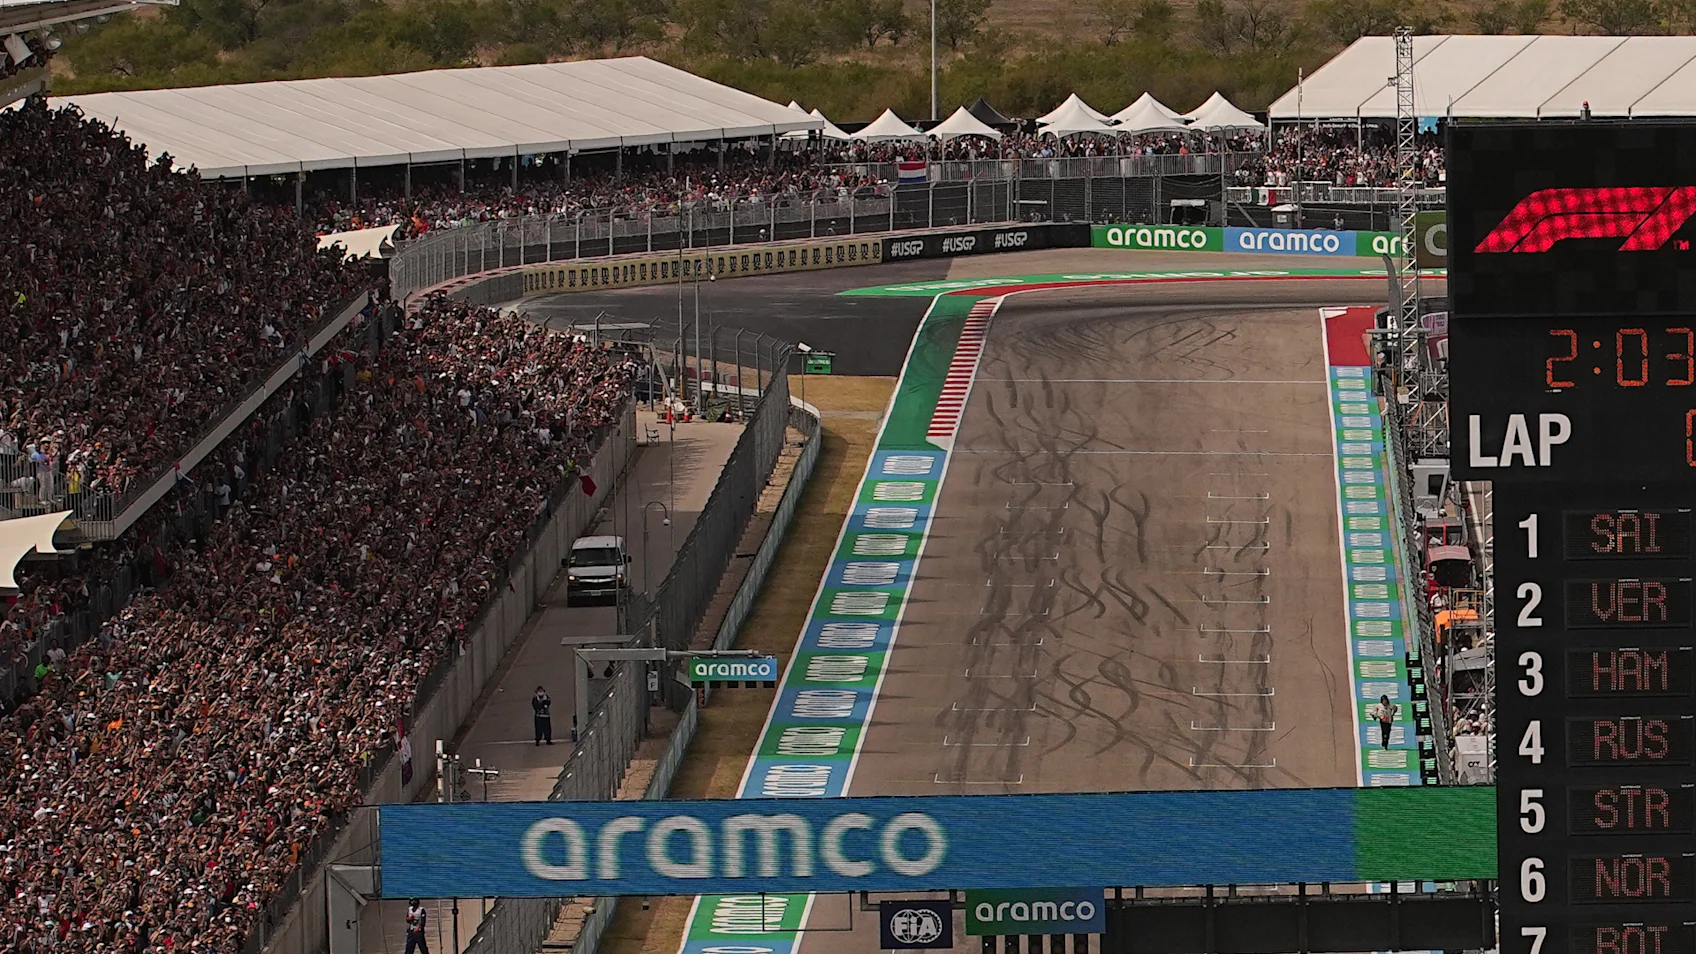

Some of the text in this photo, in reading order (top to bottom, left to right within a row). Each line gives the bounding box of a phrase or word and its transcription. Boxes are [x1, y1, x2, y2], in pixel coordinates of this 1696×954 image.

[891, 240, 924, 257] #USGP
[942, 236, 976, 253] #USGP
[994, 232, 1028, 249] #USGP
[1107, 227, 1207, 249] aramco
[1239, 231, 1340, 253] aramco
[1546, 327, 1695, 387] 2:03
[1468, 413, 1572, 468] LAP
[1518, 513, 1661, 559] 1 SAI
[1516, 582, 1667, 627] 2 VER
[695, 663, 770, 676] aramco
[1518, 651, 1668, 697] 3 HAM
[1518, 719, 1669, 764] 4 RUS
[1519, 788, 1670, 834] 5 STR
[520, 812, 947, 881] aramco
[1520, 857, 1670, 903] 6 NOR
[975, 901, 1095, 922] aramco
